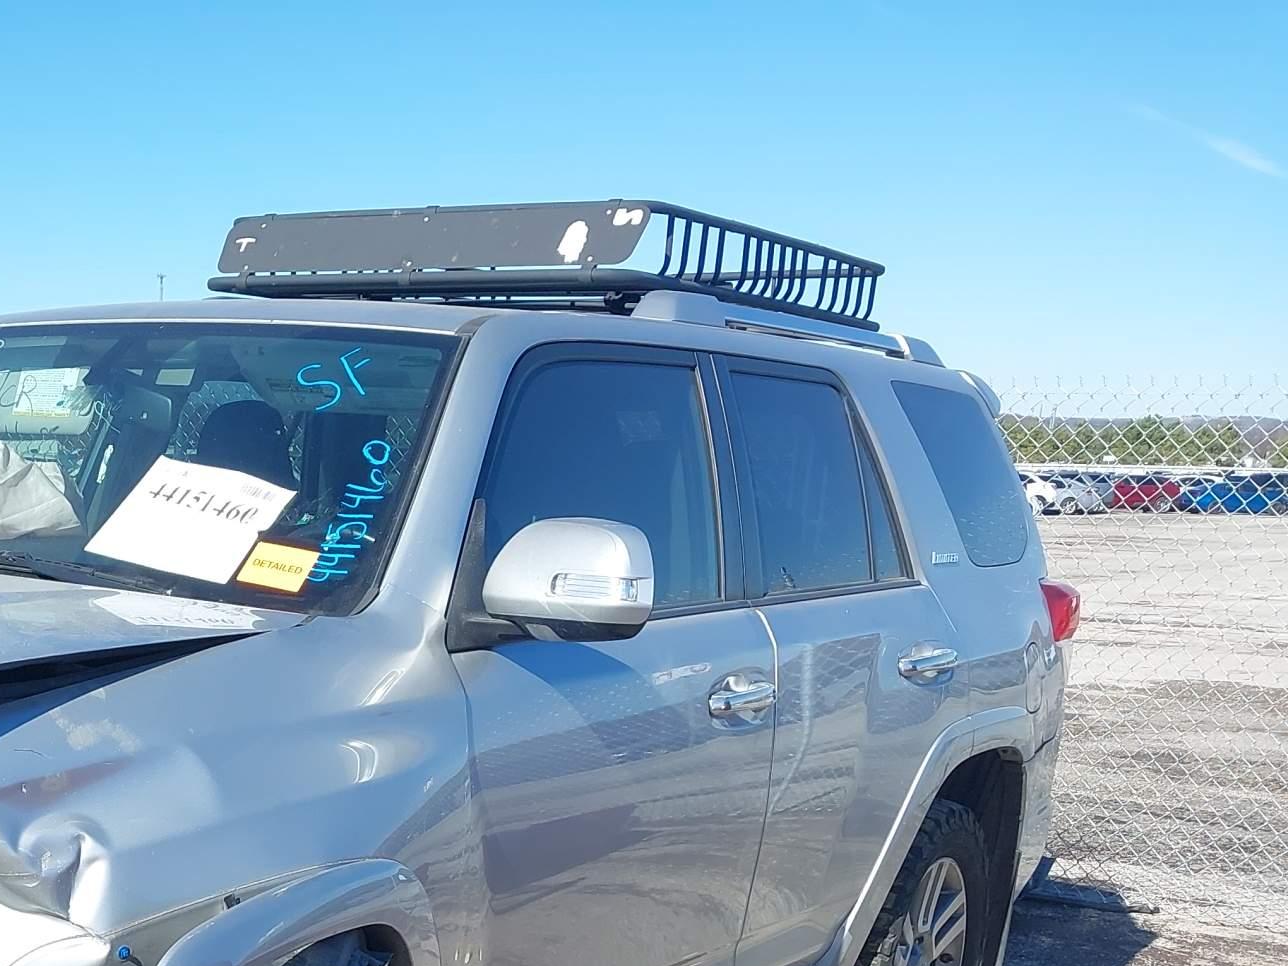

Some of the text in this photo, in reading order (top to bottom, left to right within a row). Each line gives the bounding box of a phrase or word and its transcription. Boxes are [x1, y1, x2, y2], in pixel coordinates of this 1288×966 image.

[296, 347, 372, 411] SF
[149, 483, 259, 524] 44151460
[306, 439, 391, 582] 44151460
[251, 557, 304, 576] DETAILED
